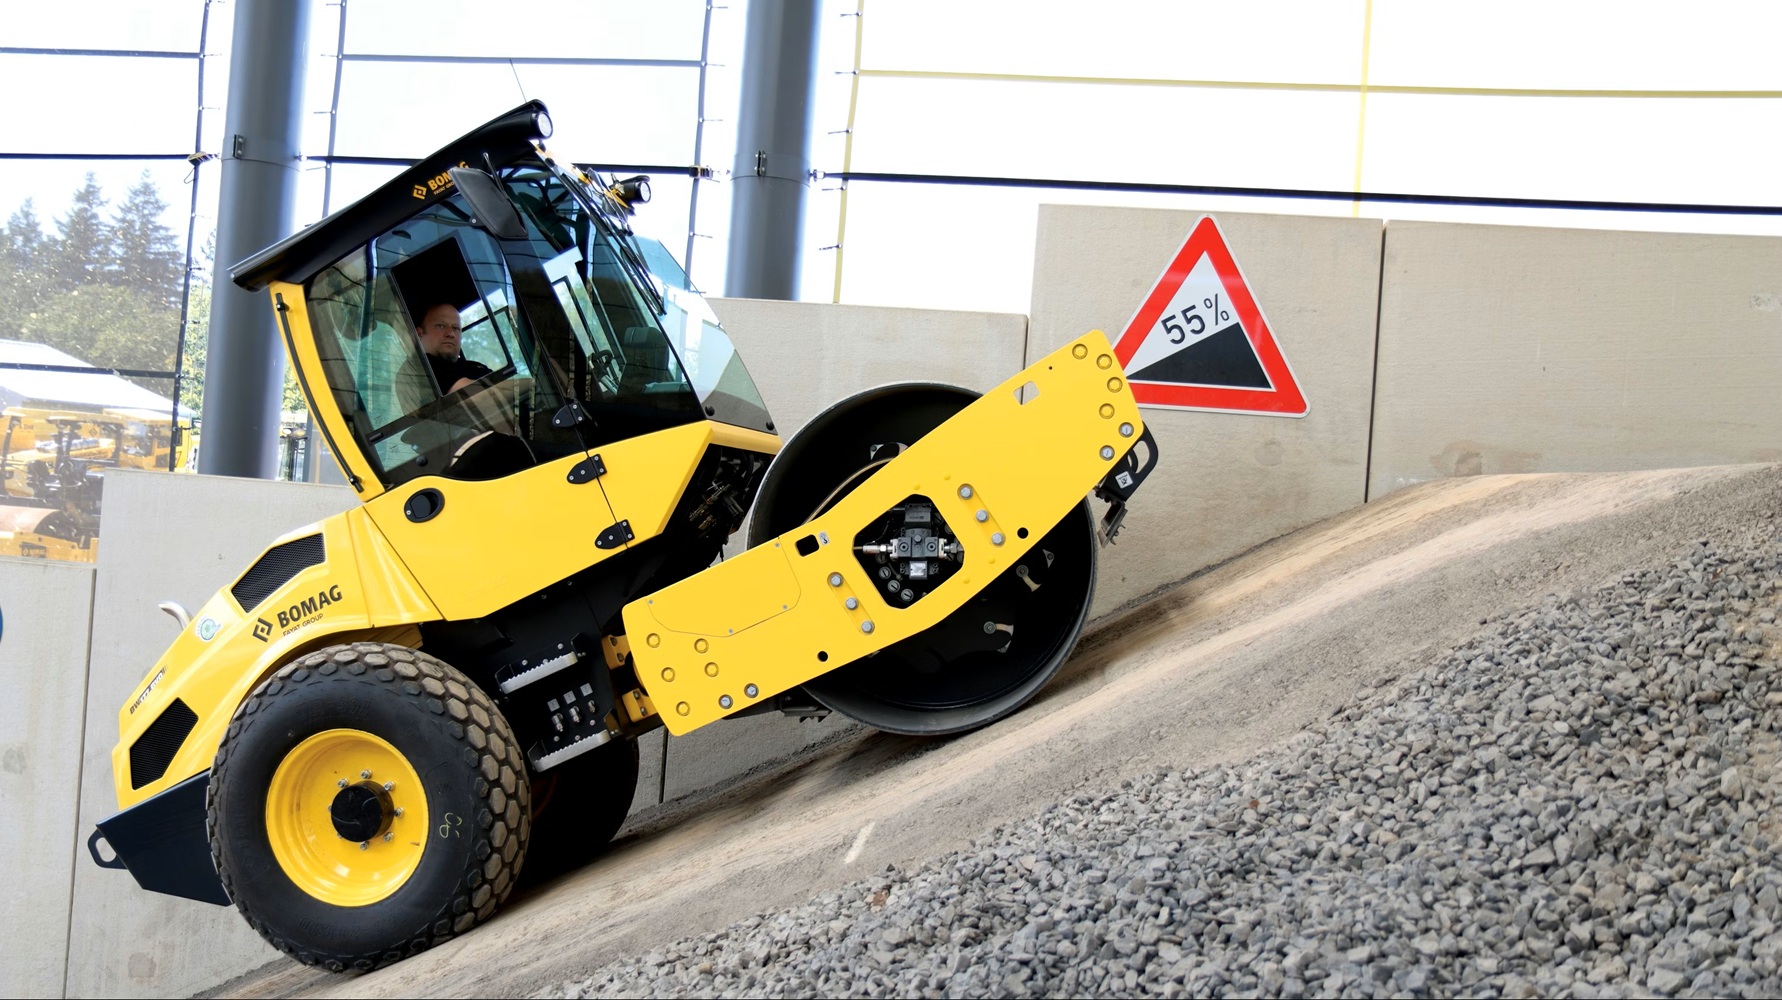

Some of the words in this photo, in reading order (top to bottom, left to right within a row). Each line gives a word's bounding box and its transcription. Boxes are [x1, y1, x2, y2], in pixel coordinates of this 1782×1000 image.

[427, 161, 470, 190] BOMG
[277, 584, 343, 628] BOMAG
[282, 623, 301, 637] FAYAT
[302, 612, 324, 628] GROUP
